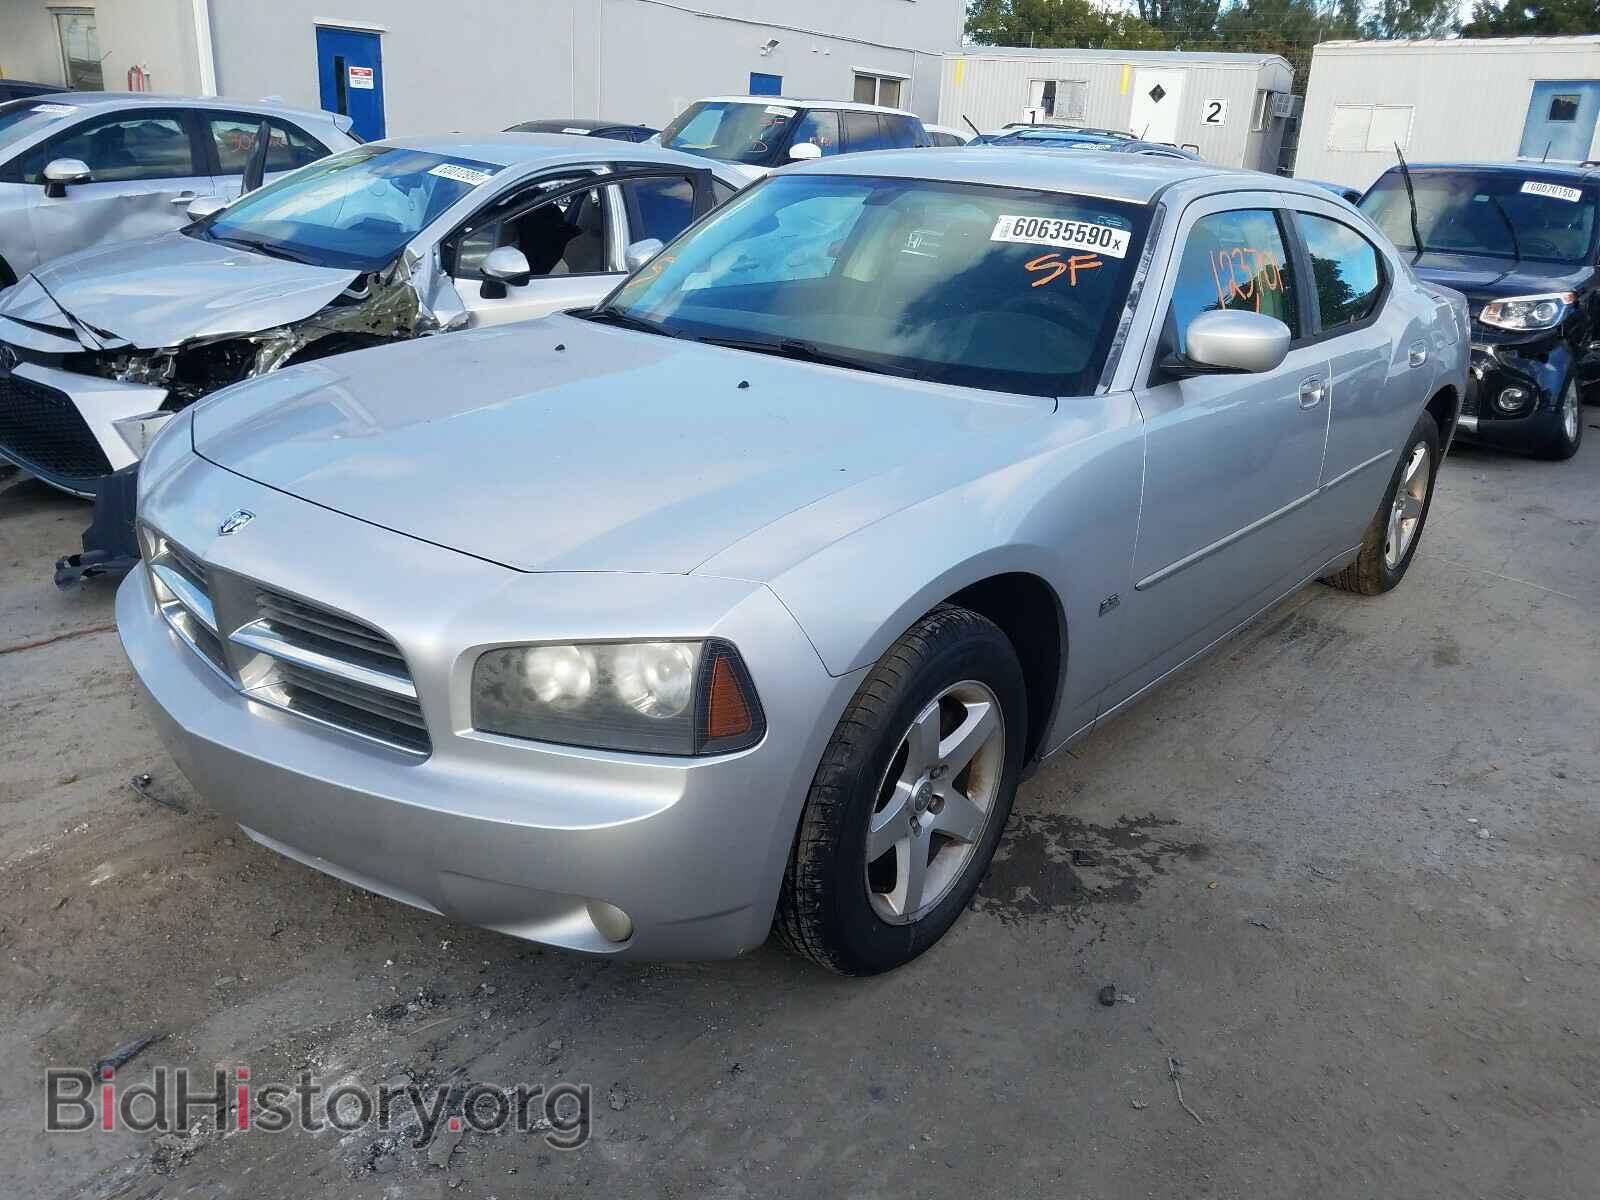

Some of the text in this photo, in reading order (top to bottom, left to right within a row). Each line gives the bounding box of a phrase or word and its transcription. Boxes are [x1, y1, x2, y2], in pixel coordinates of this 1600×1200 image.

[1029, 110, 1037, 124] 1
[1206, 102, 1222, 123] 2
[1024, 252, 1104, 288] SF
